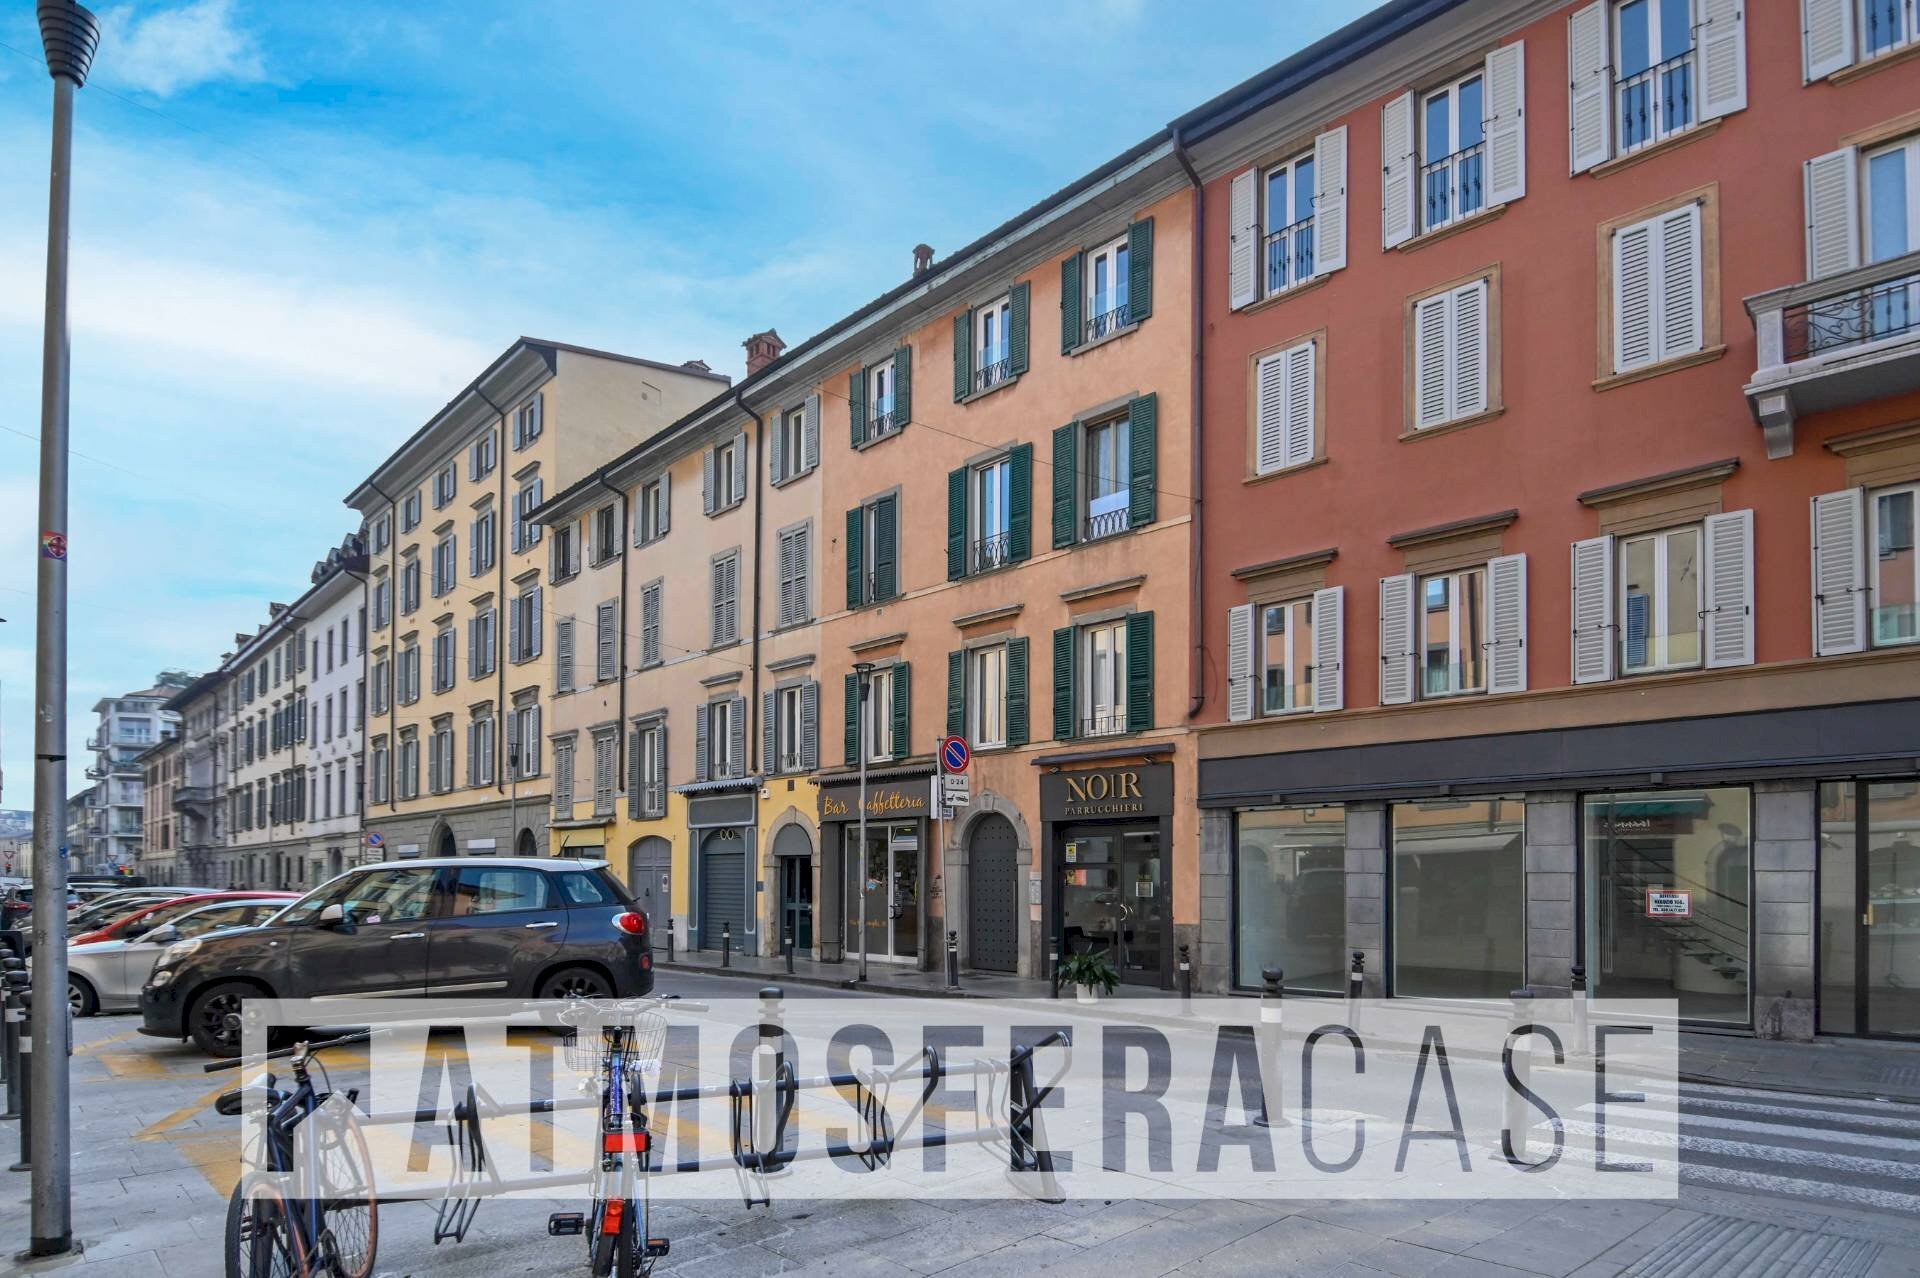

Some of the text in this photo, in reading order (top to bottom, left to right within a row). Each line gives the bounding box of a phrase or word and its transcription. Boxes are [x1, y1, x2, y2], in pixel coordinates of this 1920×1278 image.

[1066, 772, 1143, 802] NOIR
[824, 795, 849, 816] Bar
[1065, 803, 1143, 815] PARRUCCHIERI
